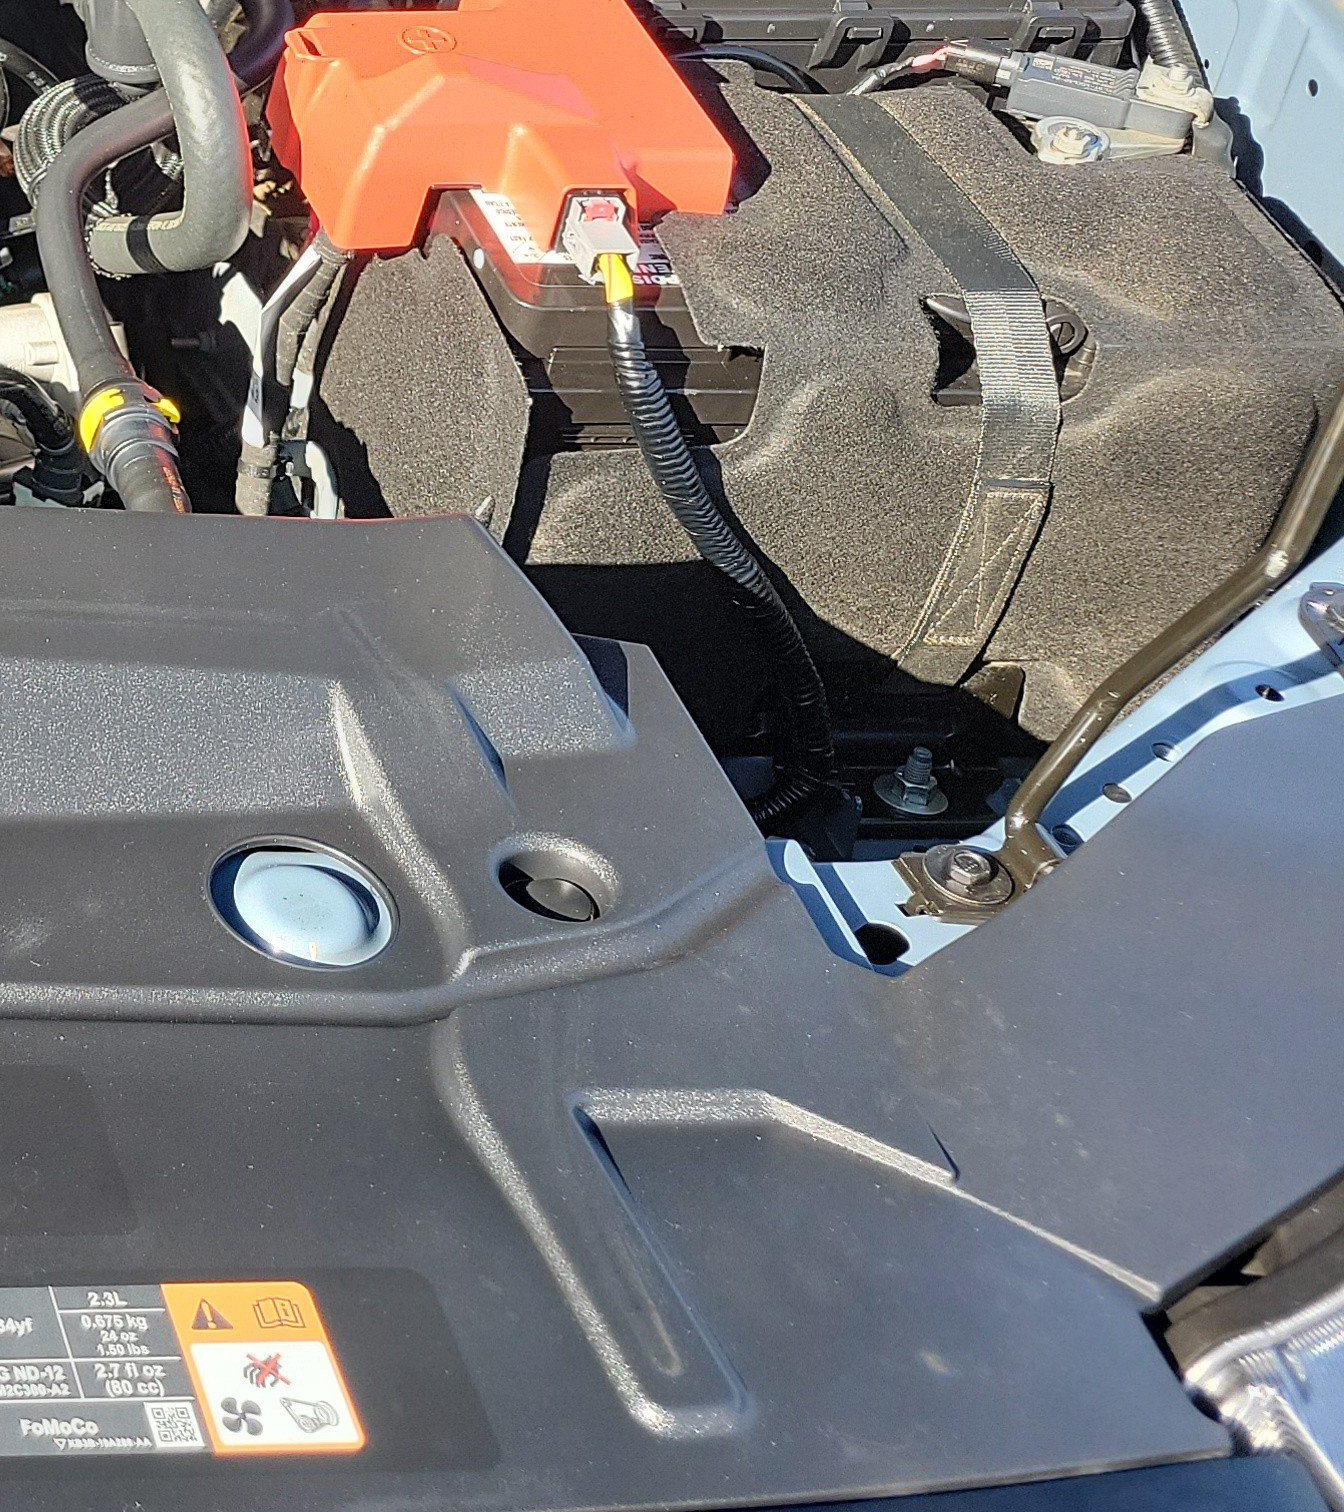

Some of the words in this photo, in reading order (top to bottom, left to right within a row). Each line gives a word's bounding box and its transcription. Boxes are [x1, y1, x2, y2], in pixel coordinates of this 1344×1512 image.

[87, 1291, 128, 1307] 2.3L
[80, 1314, 124, 1329] 0.675
[125, 1313, 148, 1332] kg
[100, 1330, 118, 1343] 24
[120, 1331, 139, 1342] oz
[96, 1344, 125, 1356] 1.50
[128, 1343, 150, 1355] lbs
[12, 1364, 67, 1382] ND-12
[94, 1363, 120, 1380] 2.7
[124, 1362, 139, 1378] fl
[142, 1364, 166, 1379] oz
[105, 1379, 133, 1398] (80
[137, 1378, 165, 1397] cc)
[19, 1417, 100, 1437] FoMoCo
